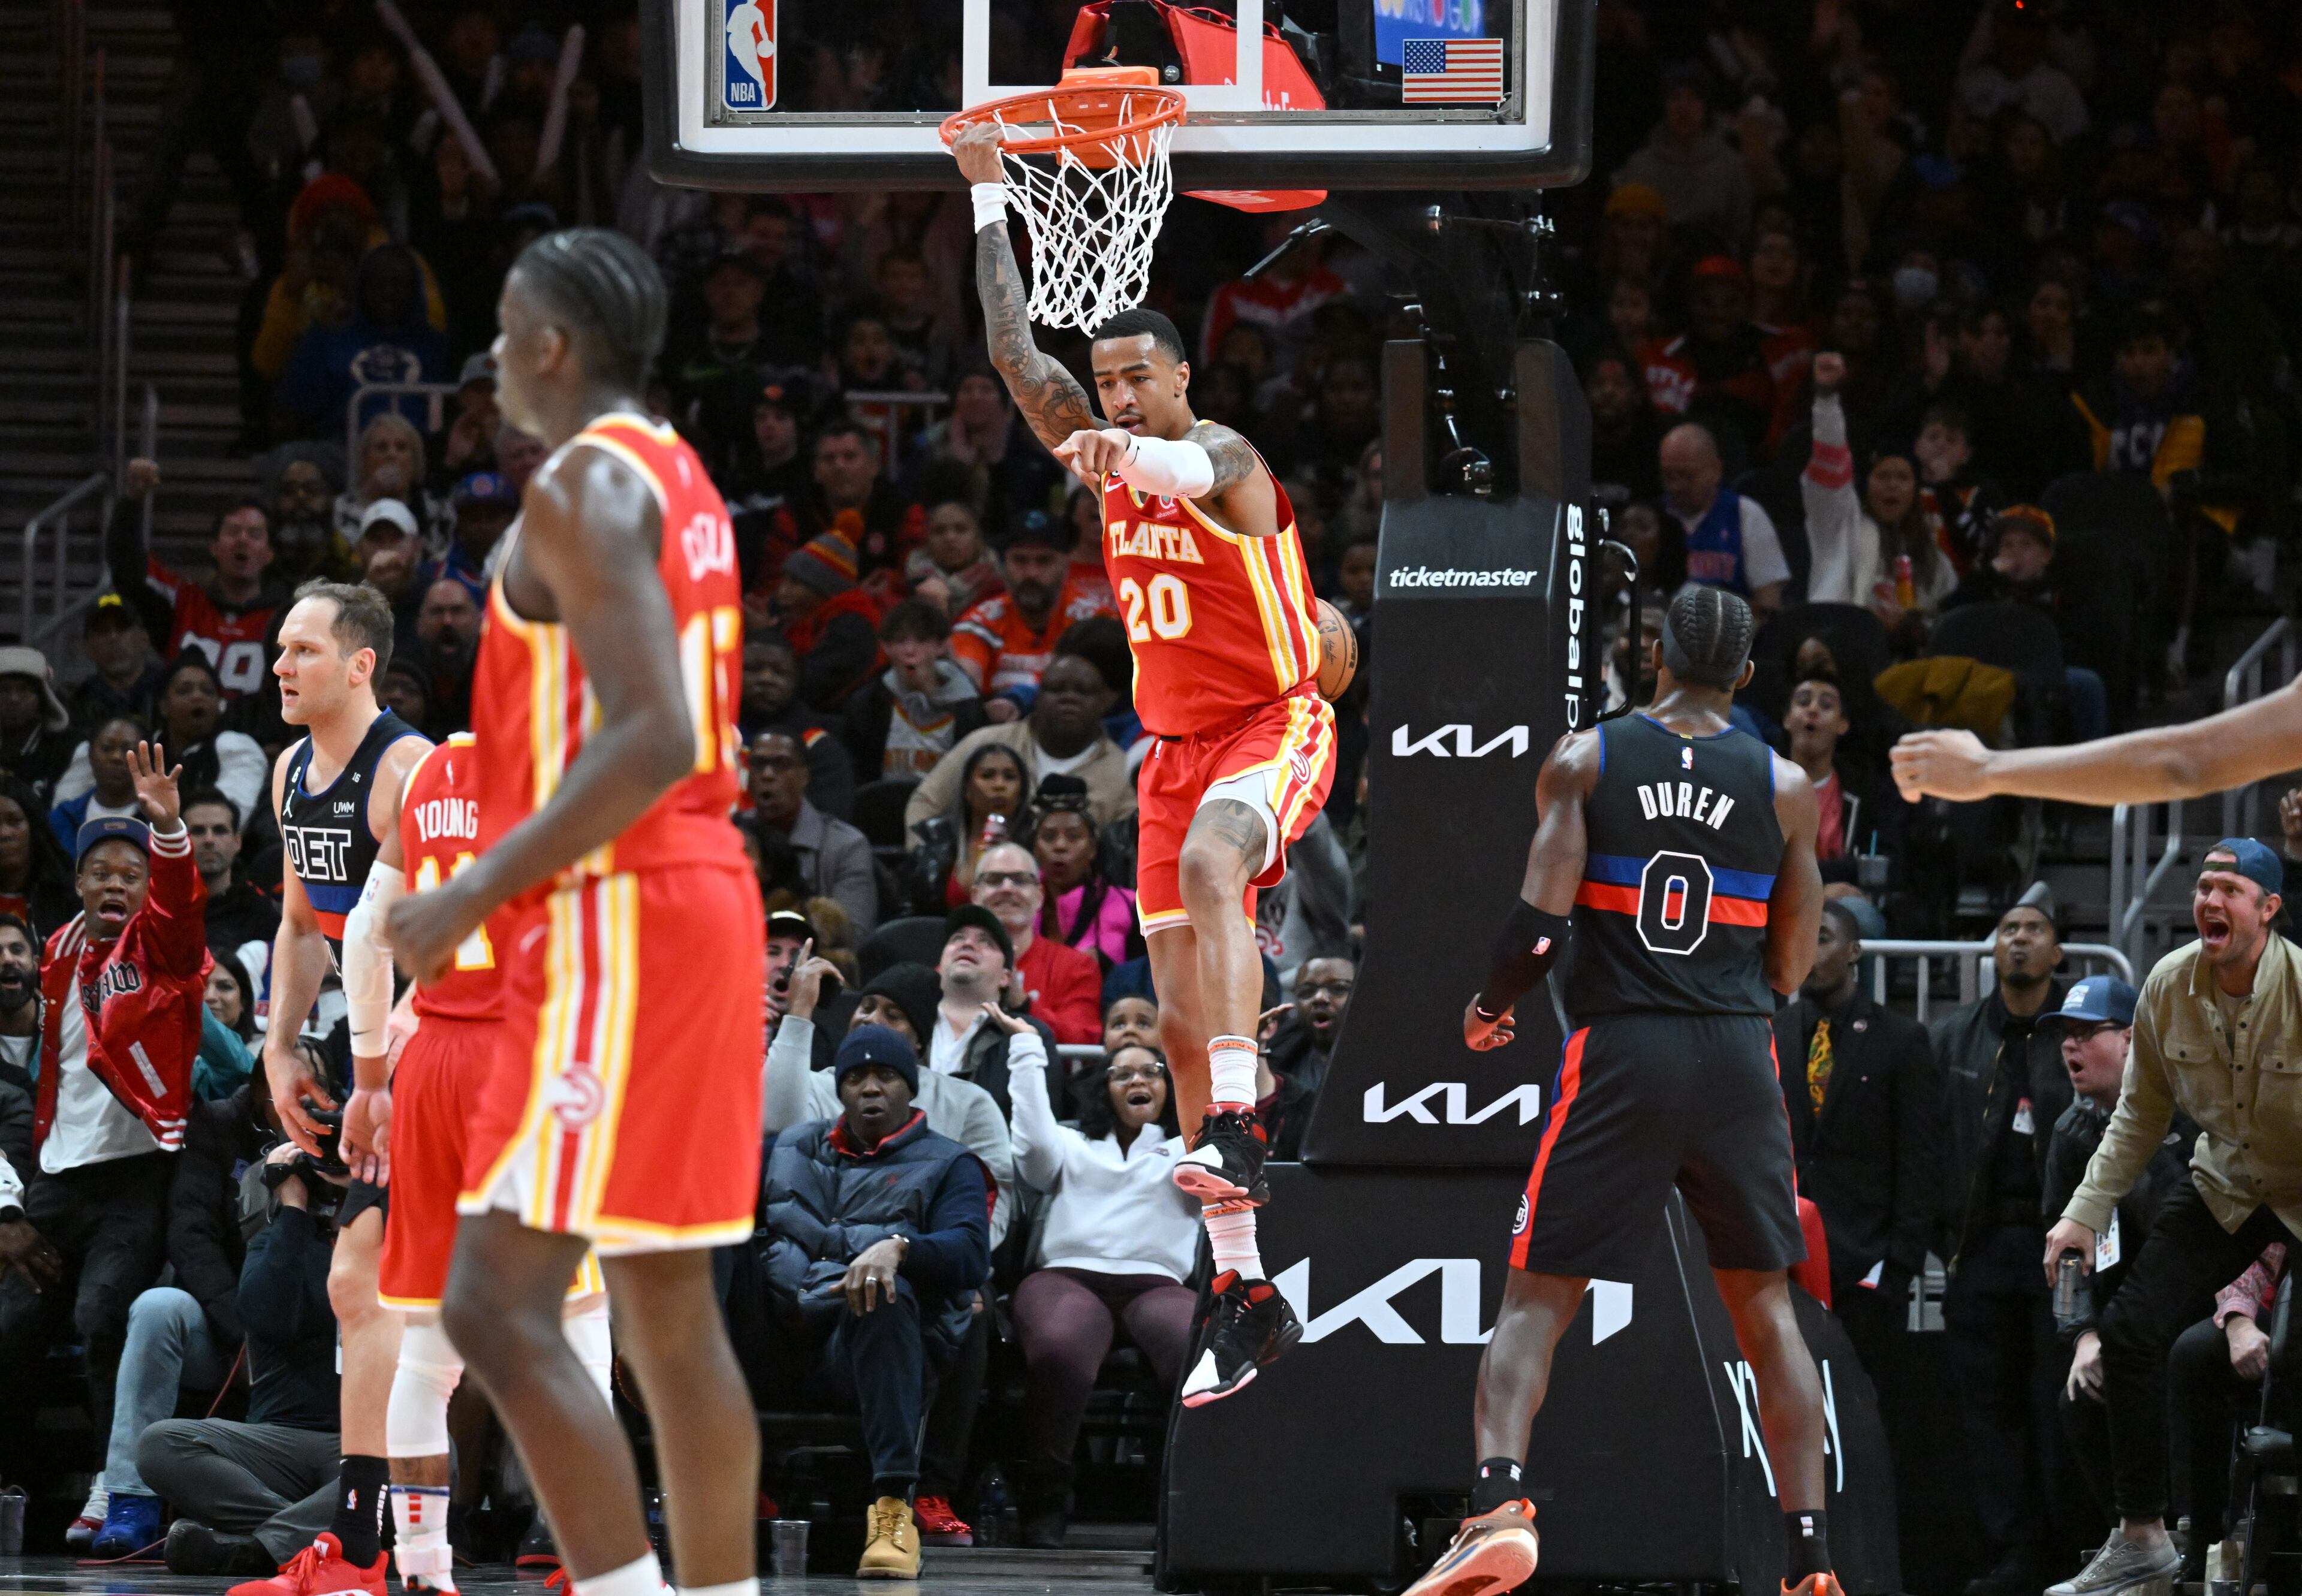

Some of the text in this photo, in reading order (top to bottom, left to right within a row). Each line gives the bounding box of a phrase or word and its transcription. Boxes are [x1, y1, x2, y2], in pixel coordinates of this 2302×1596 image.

[731, 83, 755, 101] NBA
[1110, 520, 1205, 565] TLANTA
[1390, 566, 1538, 587] ticketmaster
[1119, 572, 1193, 643] 20
[1565, 503, 1586, 733] globalp
[1392, 723, 1529, 758] KIA
[333, 801, 355, 814] UWM
[414, 797, 478, 843] YOUNG
[1637, 782, 1735, 831] DUREN
[283, 825, 352, 881] DET
[1636, 850, 1714, 955] 0
[1364, 1081, 1540, 1126] KIA
